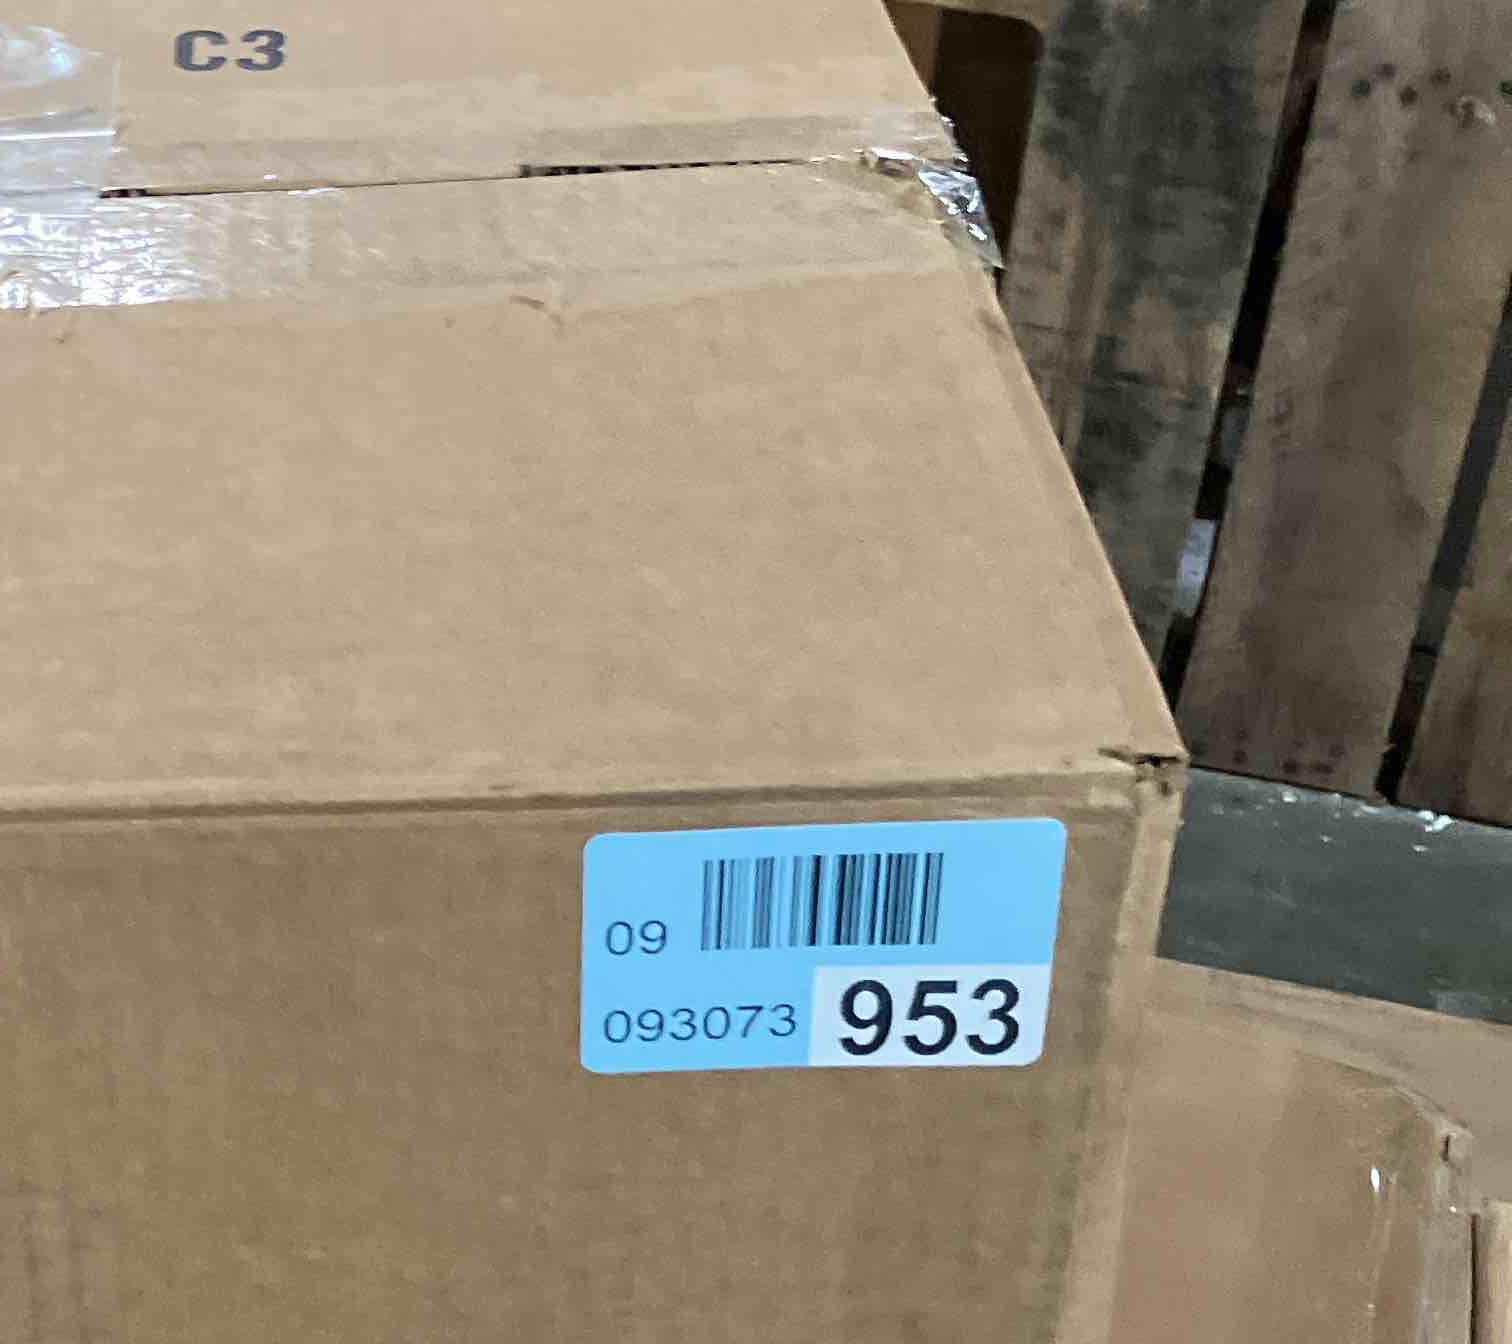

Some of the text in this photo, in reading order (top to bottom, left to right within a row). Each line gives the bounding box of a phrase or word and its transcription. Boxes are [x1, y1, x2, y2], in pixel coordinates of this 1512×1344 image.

[174, 28, 288, 73] C3
[604, 919, 668, 957] 09
[603, 977, 1021, 1058] 093073 953
